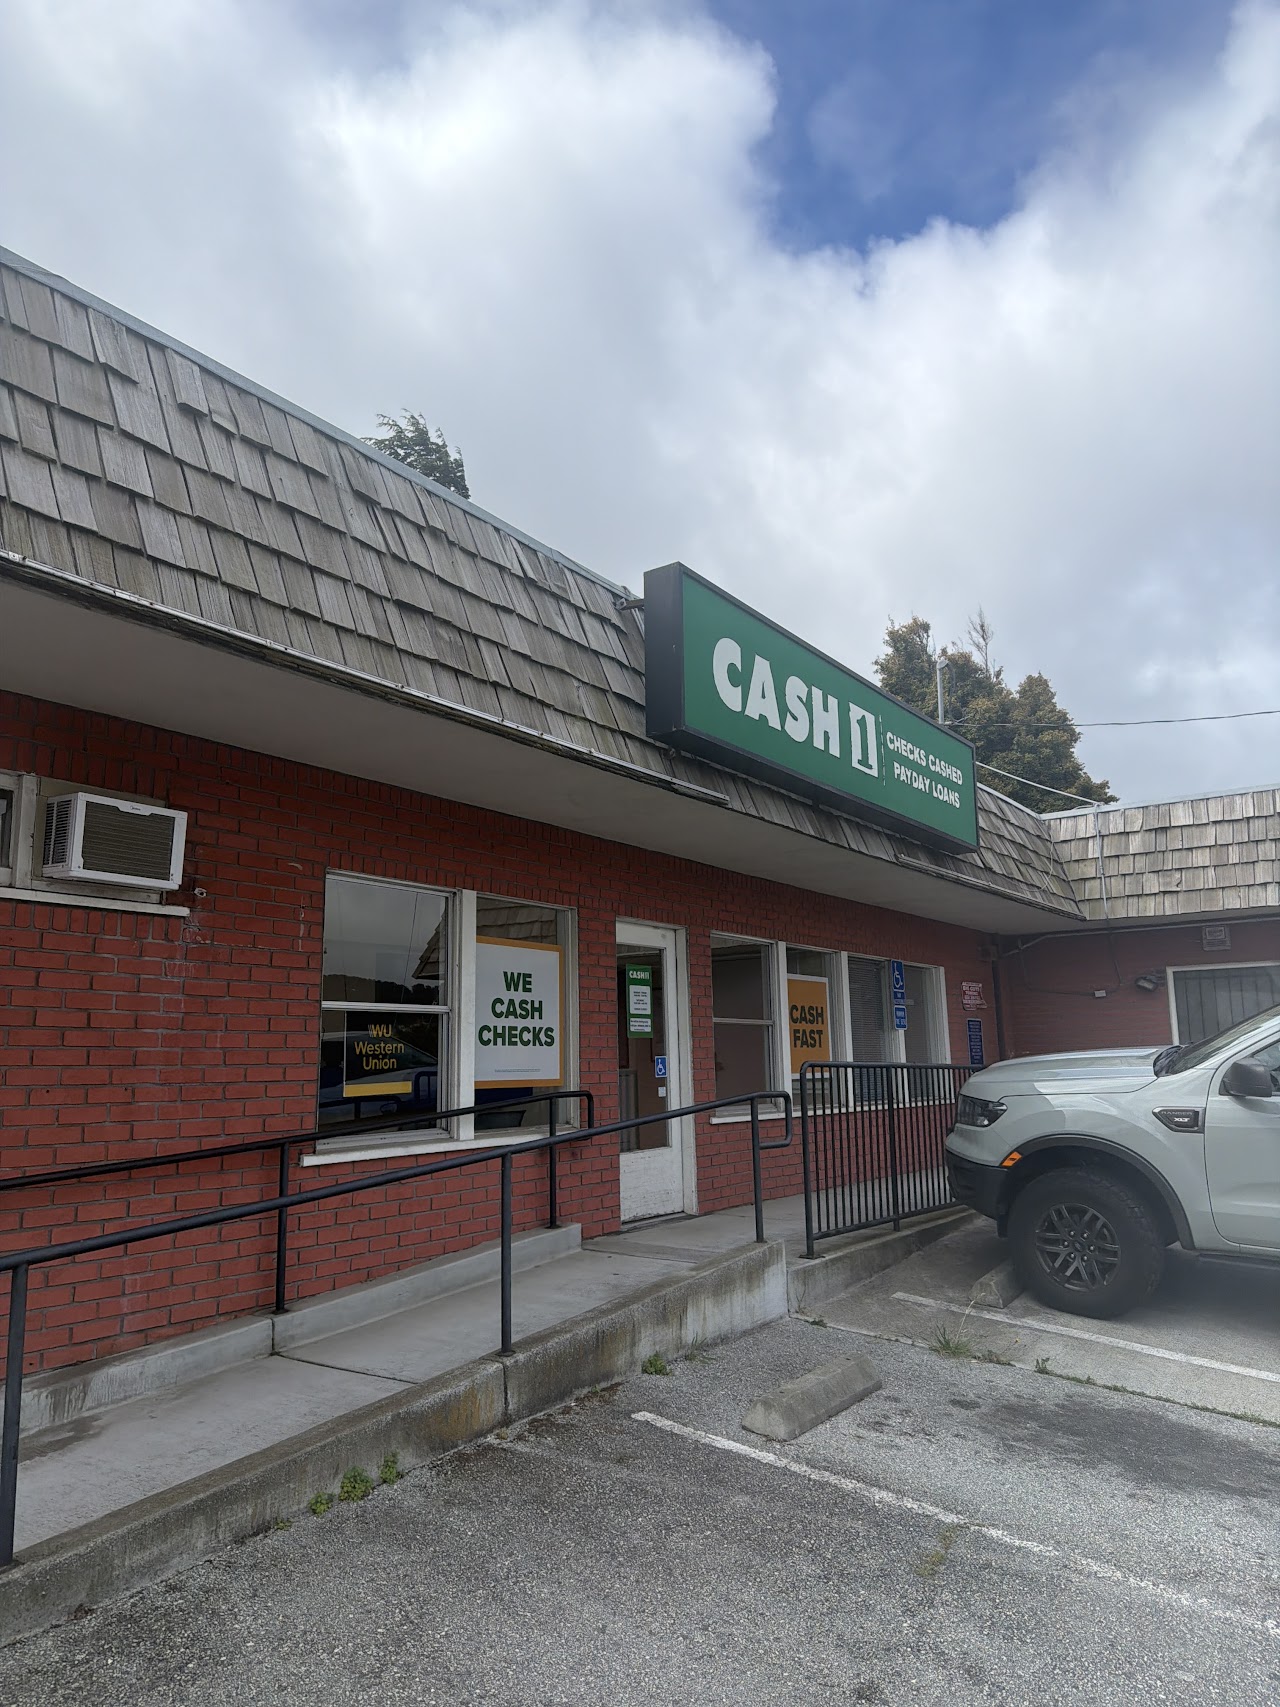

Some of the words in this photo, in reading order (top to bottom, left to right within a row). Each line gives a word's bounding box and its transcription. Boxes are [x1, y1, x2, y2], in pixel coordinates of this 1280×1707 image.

[712, 637, 840, 758] CASH
[886, 731, 927, 767] CHECKS
[928, 754, 963, 785] CASHED
[893, 761, 930, 794] PAYDAY
[932, 781, 960, 809] LOANS
[502, 970, 533, 993] WE
[629, 970, 645, 979] CASH
[490, 997, 543, 1020] CASH
[789, 1004, 825, 1025] CASH
[367, 1023, 392, 1038] WU
[477, 1024, 555, 1048] CHECKS
[792, 1028, 824, 1049] FAST
[354, 1040, 405, 1055] Western
[362, 1054, 397, 1070] Union
